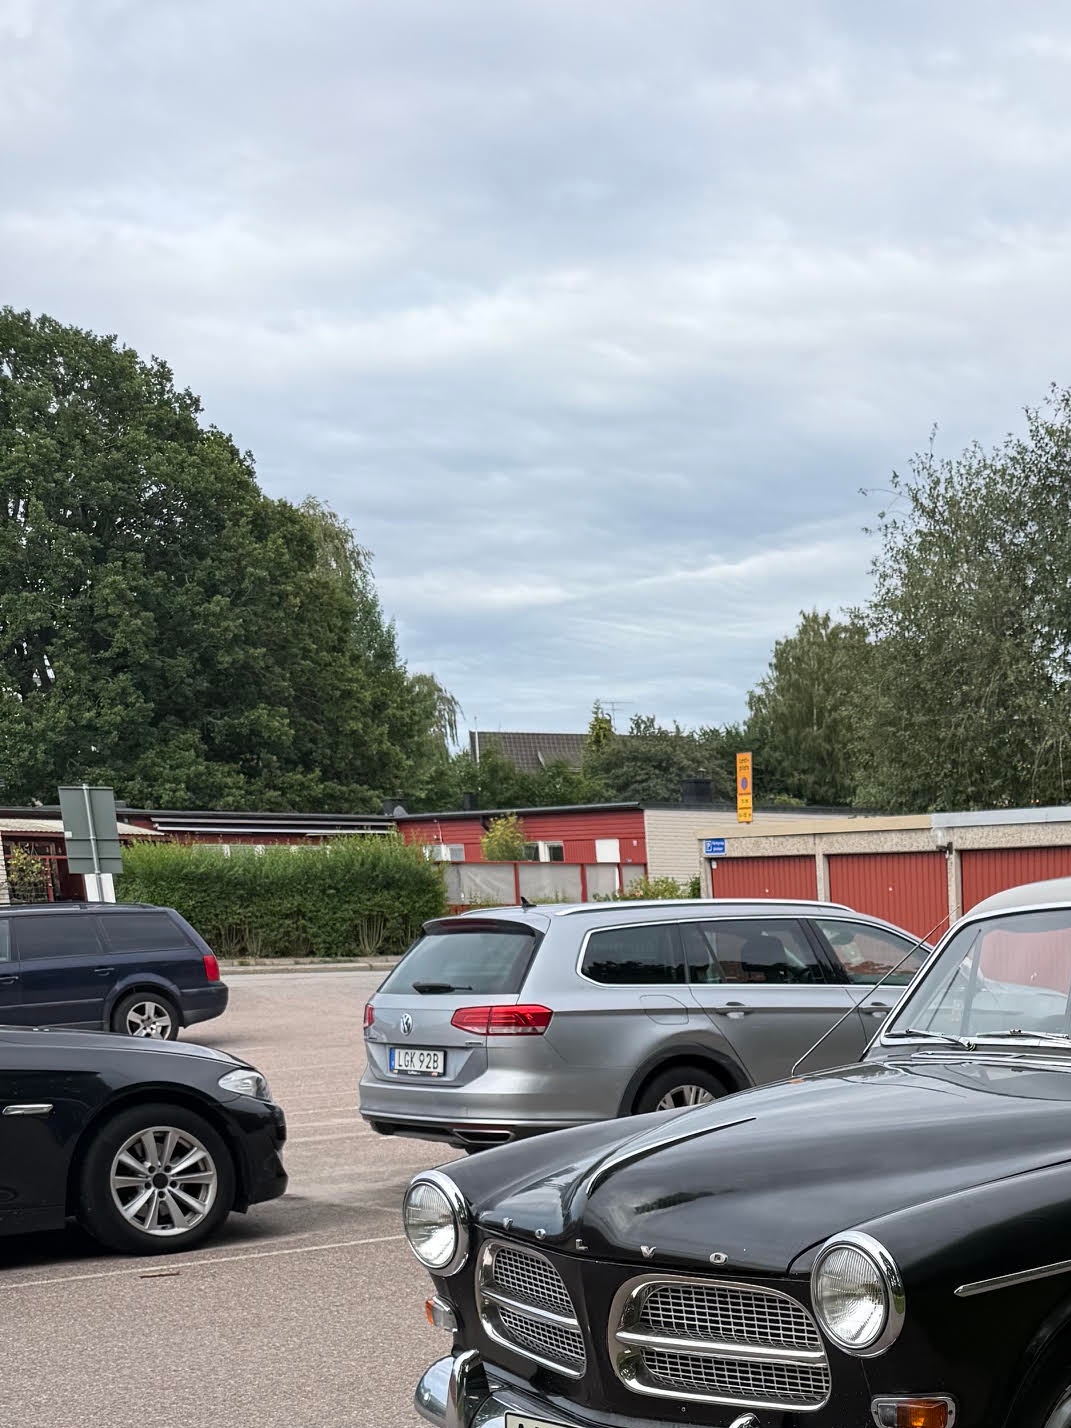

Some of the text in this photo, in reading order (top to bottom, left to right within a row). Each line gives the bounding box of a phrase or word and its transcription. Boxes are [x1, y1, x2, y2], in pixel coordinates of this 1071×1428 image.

[398, 1051, 439, 1070] LGK 92B
[503, 1218, 728, 1265] VOLVO
